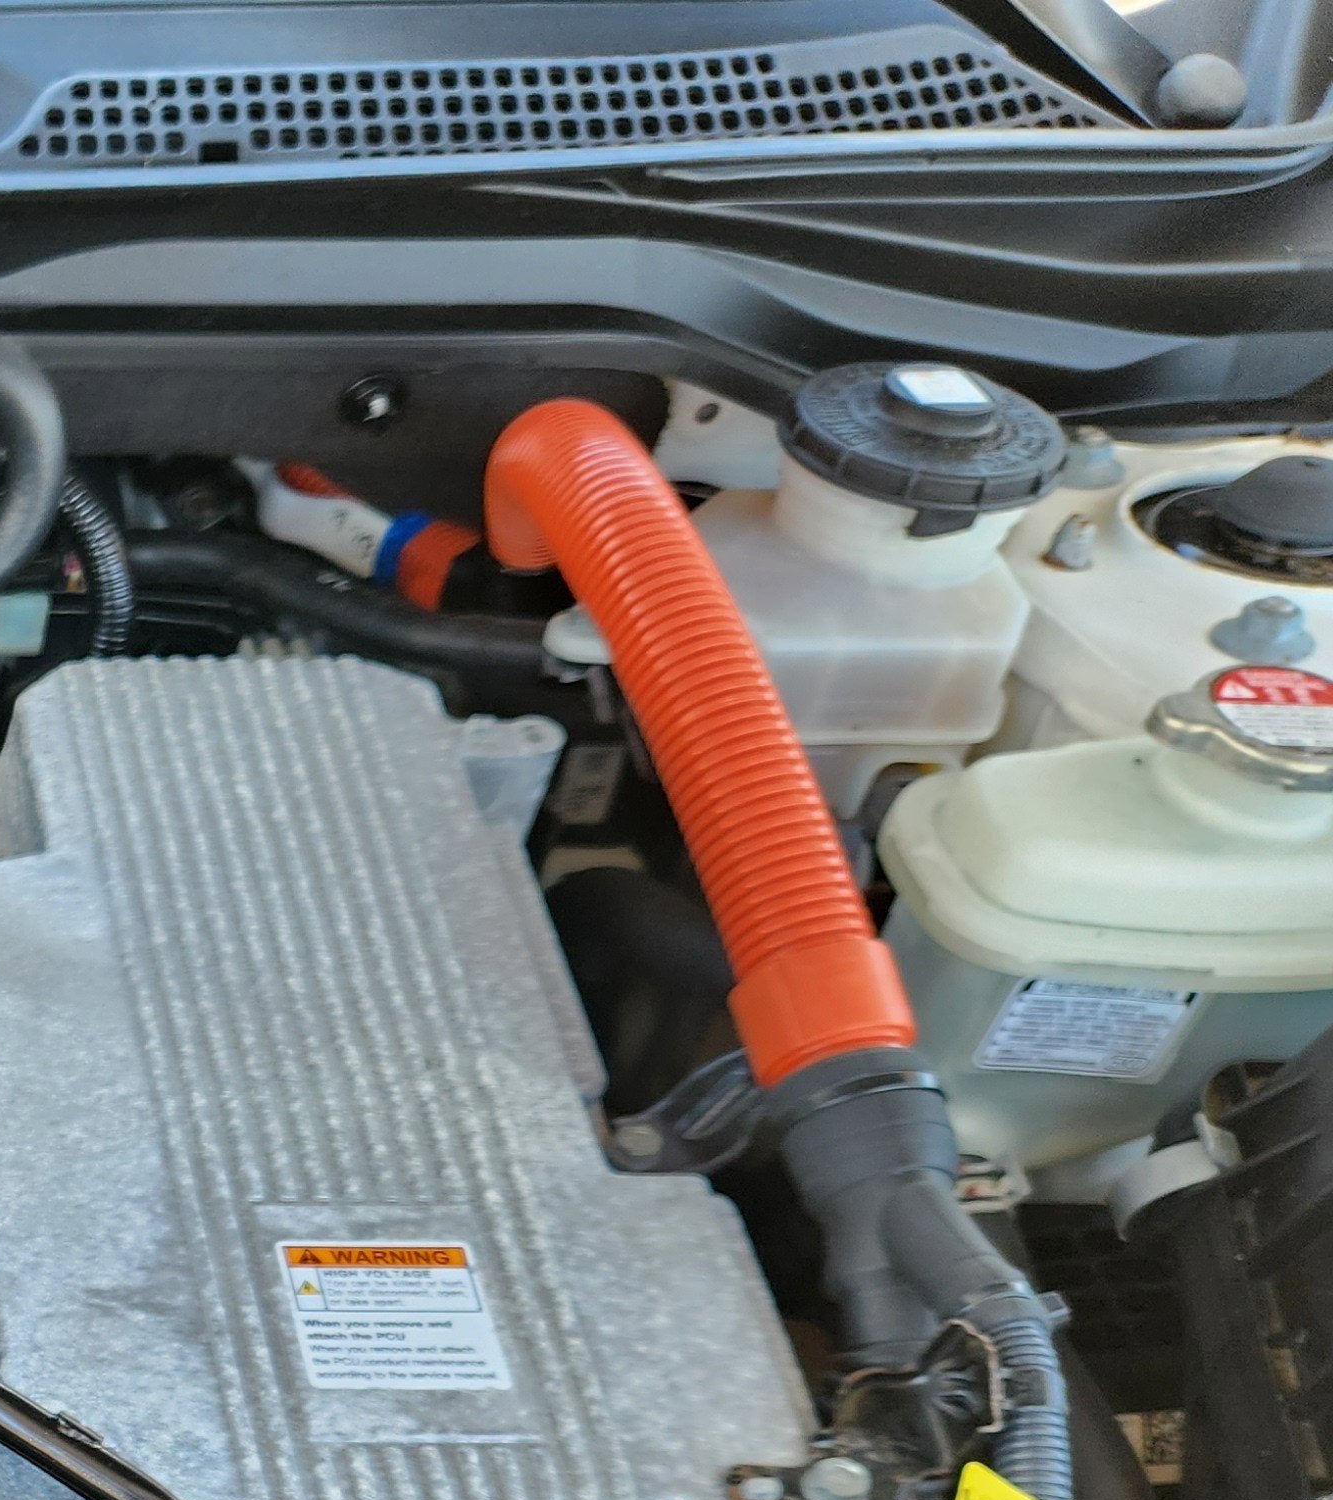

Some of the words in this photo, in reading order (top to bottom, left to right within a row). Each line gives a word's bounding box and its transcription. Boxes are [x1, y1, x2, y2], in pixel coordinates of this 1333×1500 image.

[329, 1250, 450, 1265] WARNING
[323, 1270, 358, 1278] HIGH
[364, 1270, 431, 1278] VOLTAGE
[302, 1319, 341, 1329] When
[345, 1319, 371, 1329] you
[374, 1319, 424, 1329] remove
[427, 1319, 453, 1329] and
[306, 1332, 348, 1341] attach
[351, 1332, 373, 1341] the
[376, 1332, 407, 1341] PCU
